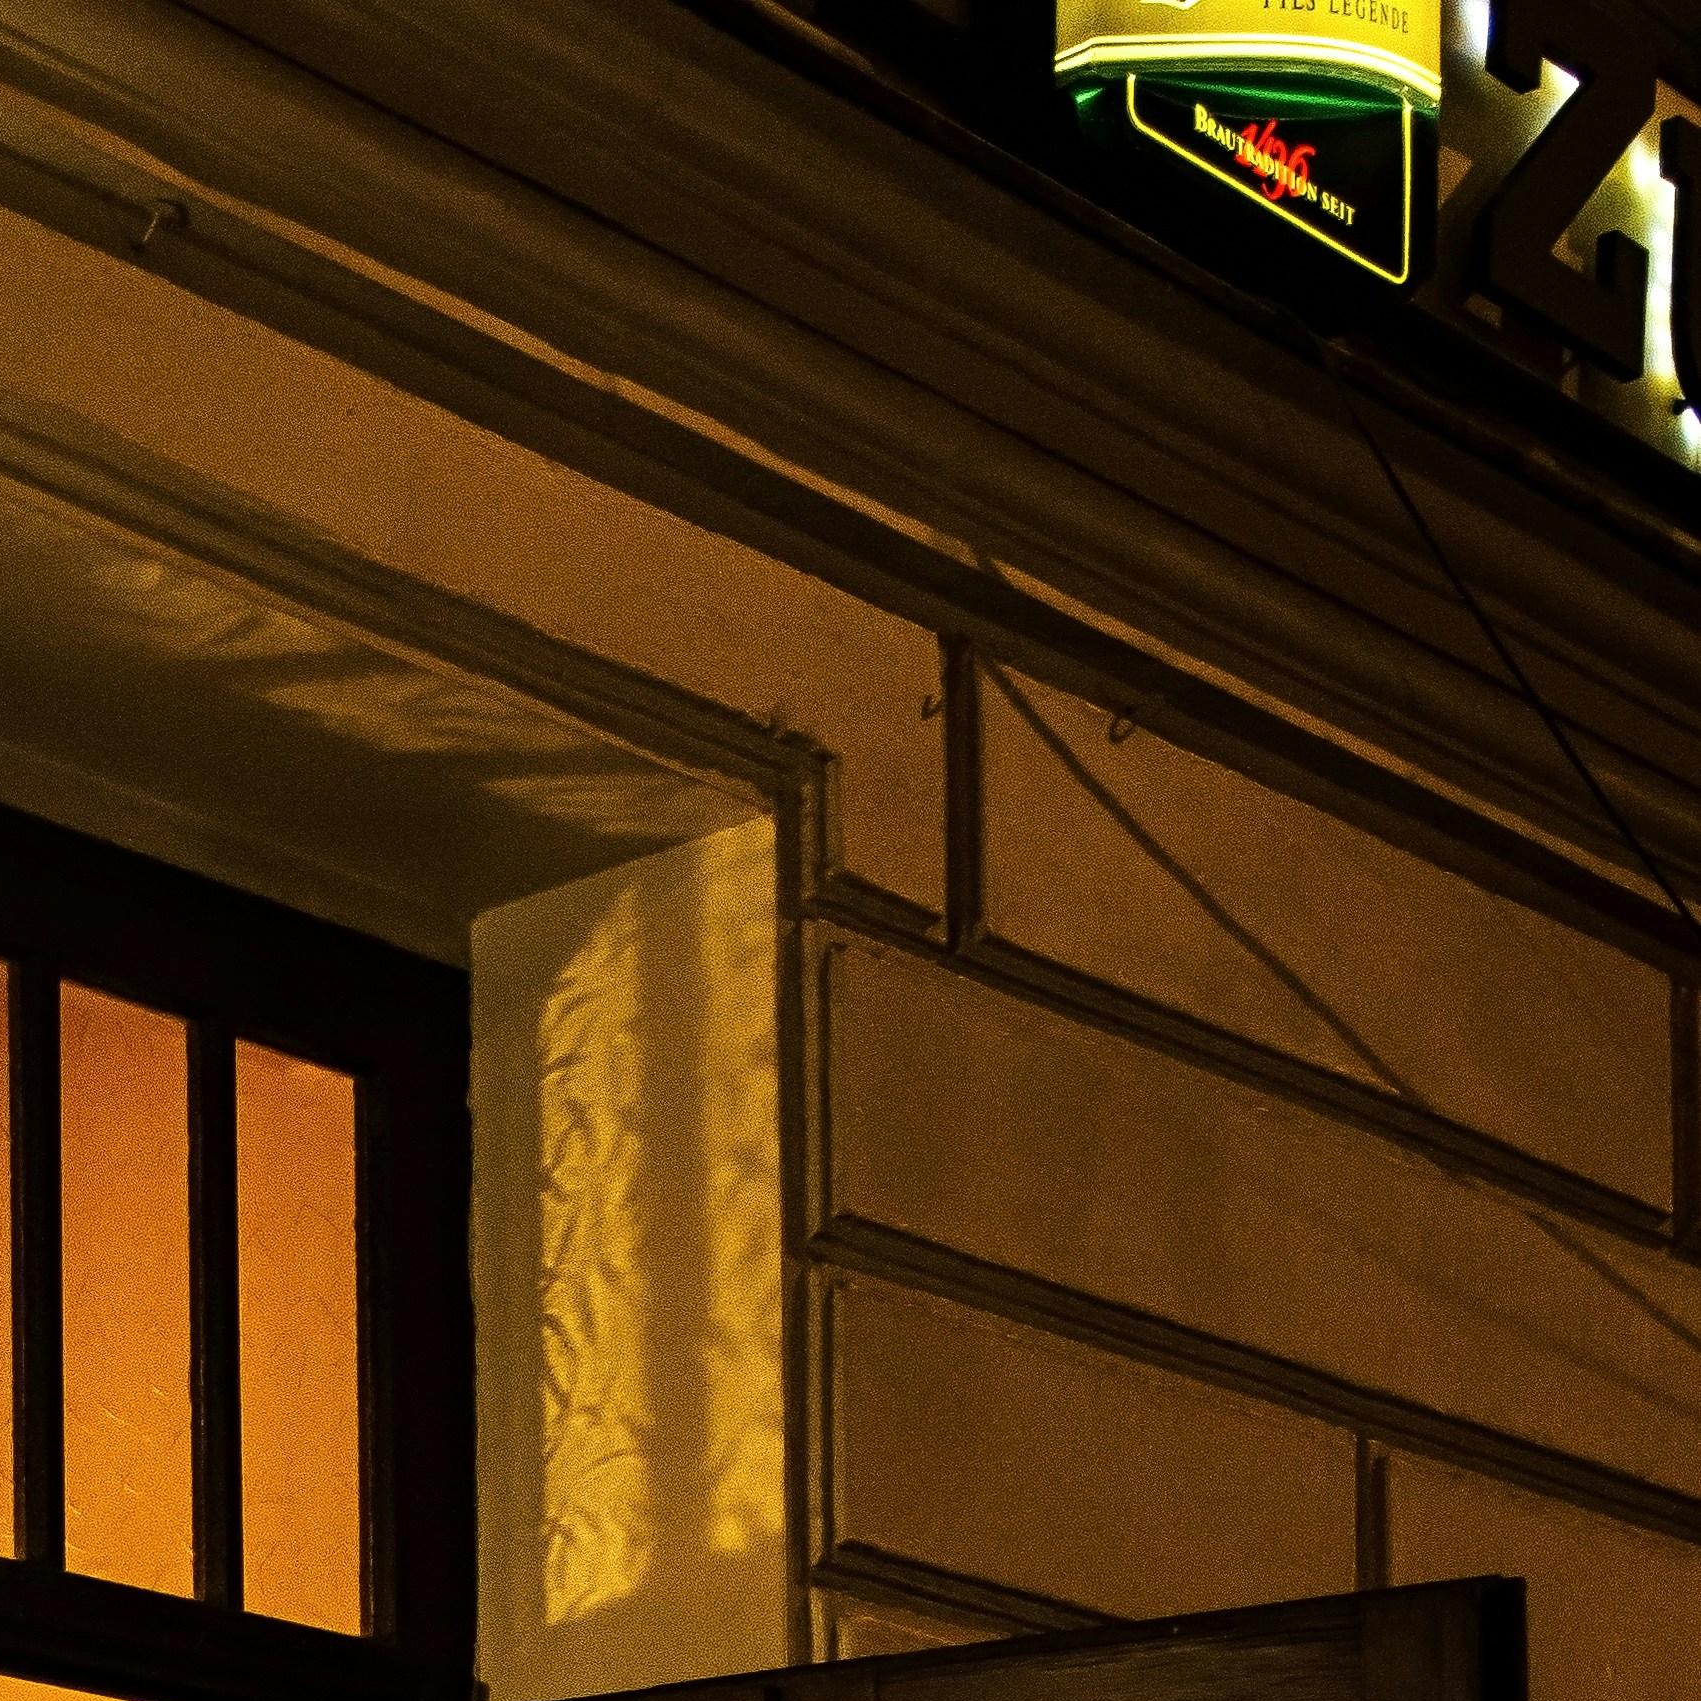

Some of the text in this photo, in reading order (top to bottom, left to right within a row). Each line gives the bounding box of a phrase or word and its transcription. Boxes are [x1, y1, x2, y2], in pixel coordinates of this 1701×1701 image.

[1329, 0, 1409, 34] LEGENDE
[1194, 103, 1356, 226] BRAUTRADITION SEIT
